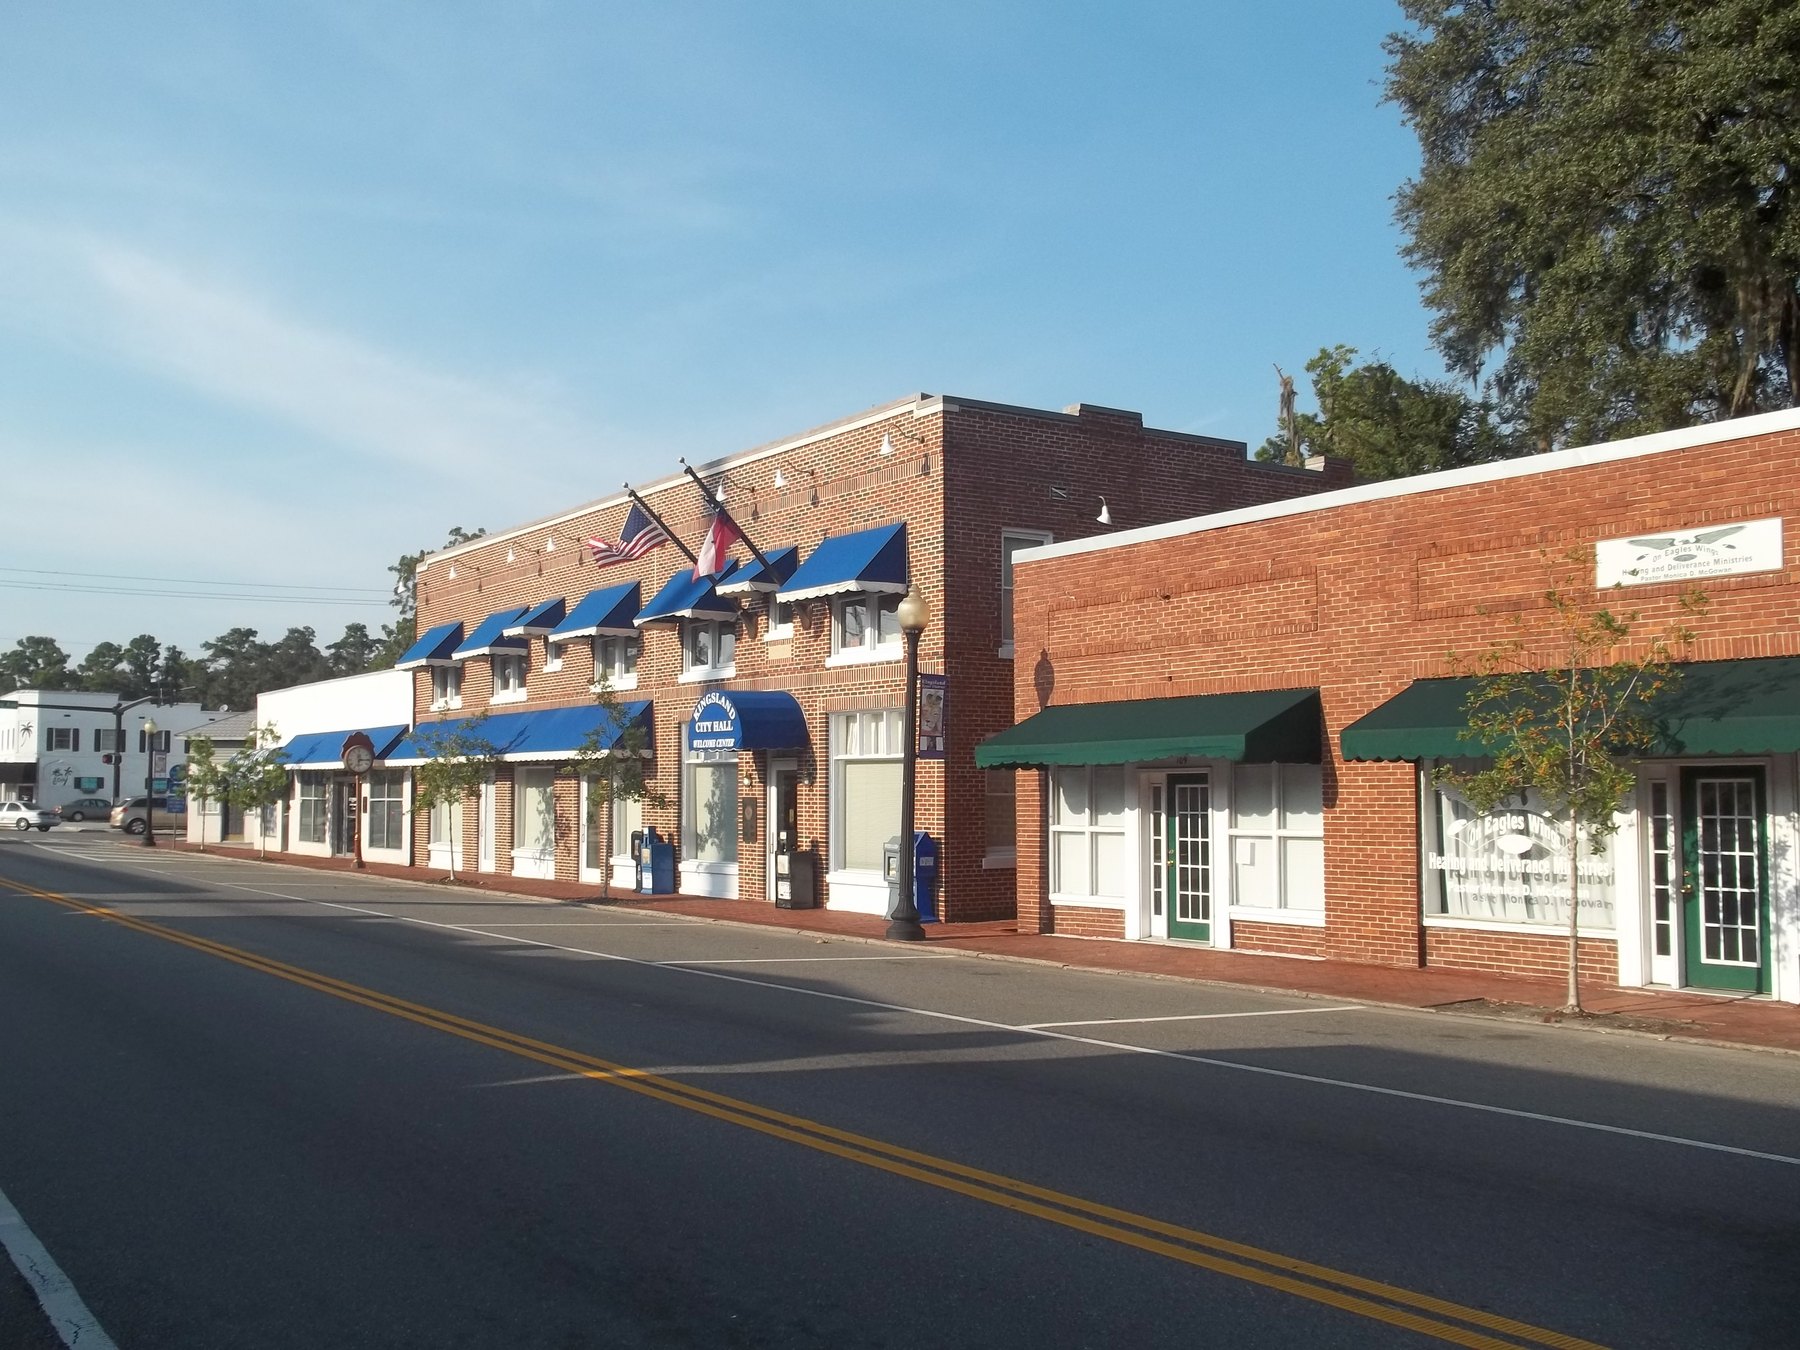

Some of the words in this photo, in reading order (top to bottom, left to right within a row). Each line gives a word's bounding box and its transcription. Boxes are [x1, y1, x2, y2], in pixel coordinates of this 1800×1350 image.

[1652, 554, 1662, 563] On
[1664, 545, 1692, 557] Eagles
[1695, 544, 1719, 556] Wings
[1622, 567, 1649, 576] Hing
[1651, 565, 1665, 573] and
[1667, 560, 1711, 571] Deliverance
[1713, 555, 1753, 566] Ministries
[1663, 571, 1687, 579] Monica
[1698, 567, 1732, 575] McGowan
[693, 692, 736, 722] KINGSLAND
[695, 721, 712, 733] CITY
[713, 720, 734, 732] HALL
[693, 739, 716, 748] WELCOME
[716, 738, 735, 748] CENTER
[1468, 825, 1482, 845] On
[1484, 813, 1525, 835] Eagles
[1527, 813, 1561, 848] Wings
[1428, 852, 1466, 874] Healing
[1468, 854, 1488, 871] and
[1490, 853, 1550, 874] Deliverance
[1553, 855, 1610, 876] Mistries
[1447, 881, 1480, 894] Pastor
[1481, 882, 1520, 895] Monica
[1523, 884, 1532, 896] D.
